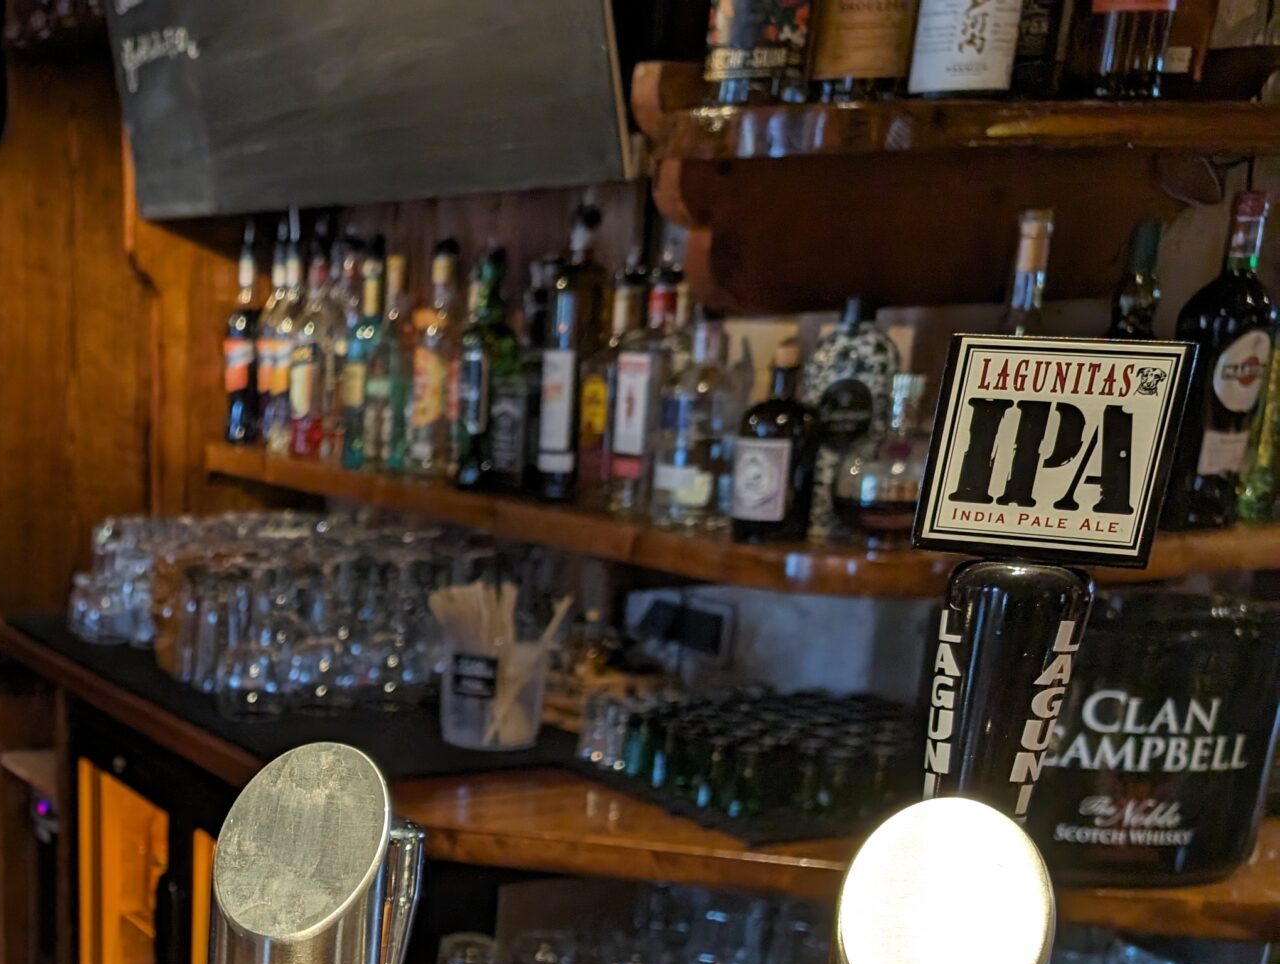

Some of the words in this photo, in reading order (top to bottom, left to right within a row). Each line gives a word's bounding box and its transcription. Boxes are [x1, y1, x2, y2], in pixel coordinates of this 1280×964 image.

[977, 358, 1135, 397] LAGUNITAS
[948, 397, 1134, 515] IPA
[952, 507, 1005, 525] INDIA
[1017, 513, 1068, 529] PALE
[1079, 518, 1119, 533] ALE
[1009, 620, 1080, 823] LAGUNI
[1082, 689, 1220, 734] CLAN
[1054, 822, 1126, 845] SCOTCH
[1129, 828, 1193, 846] WHISKY
